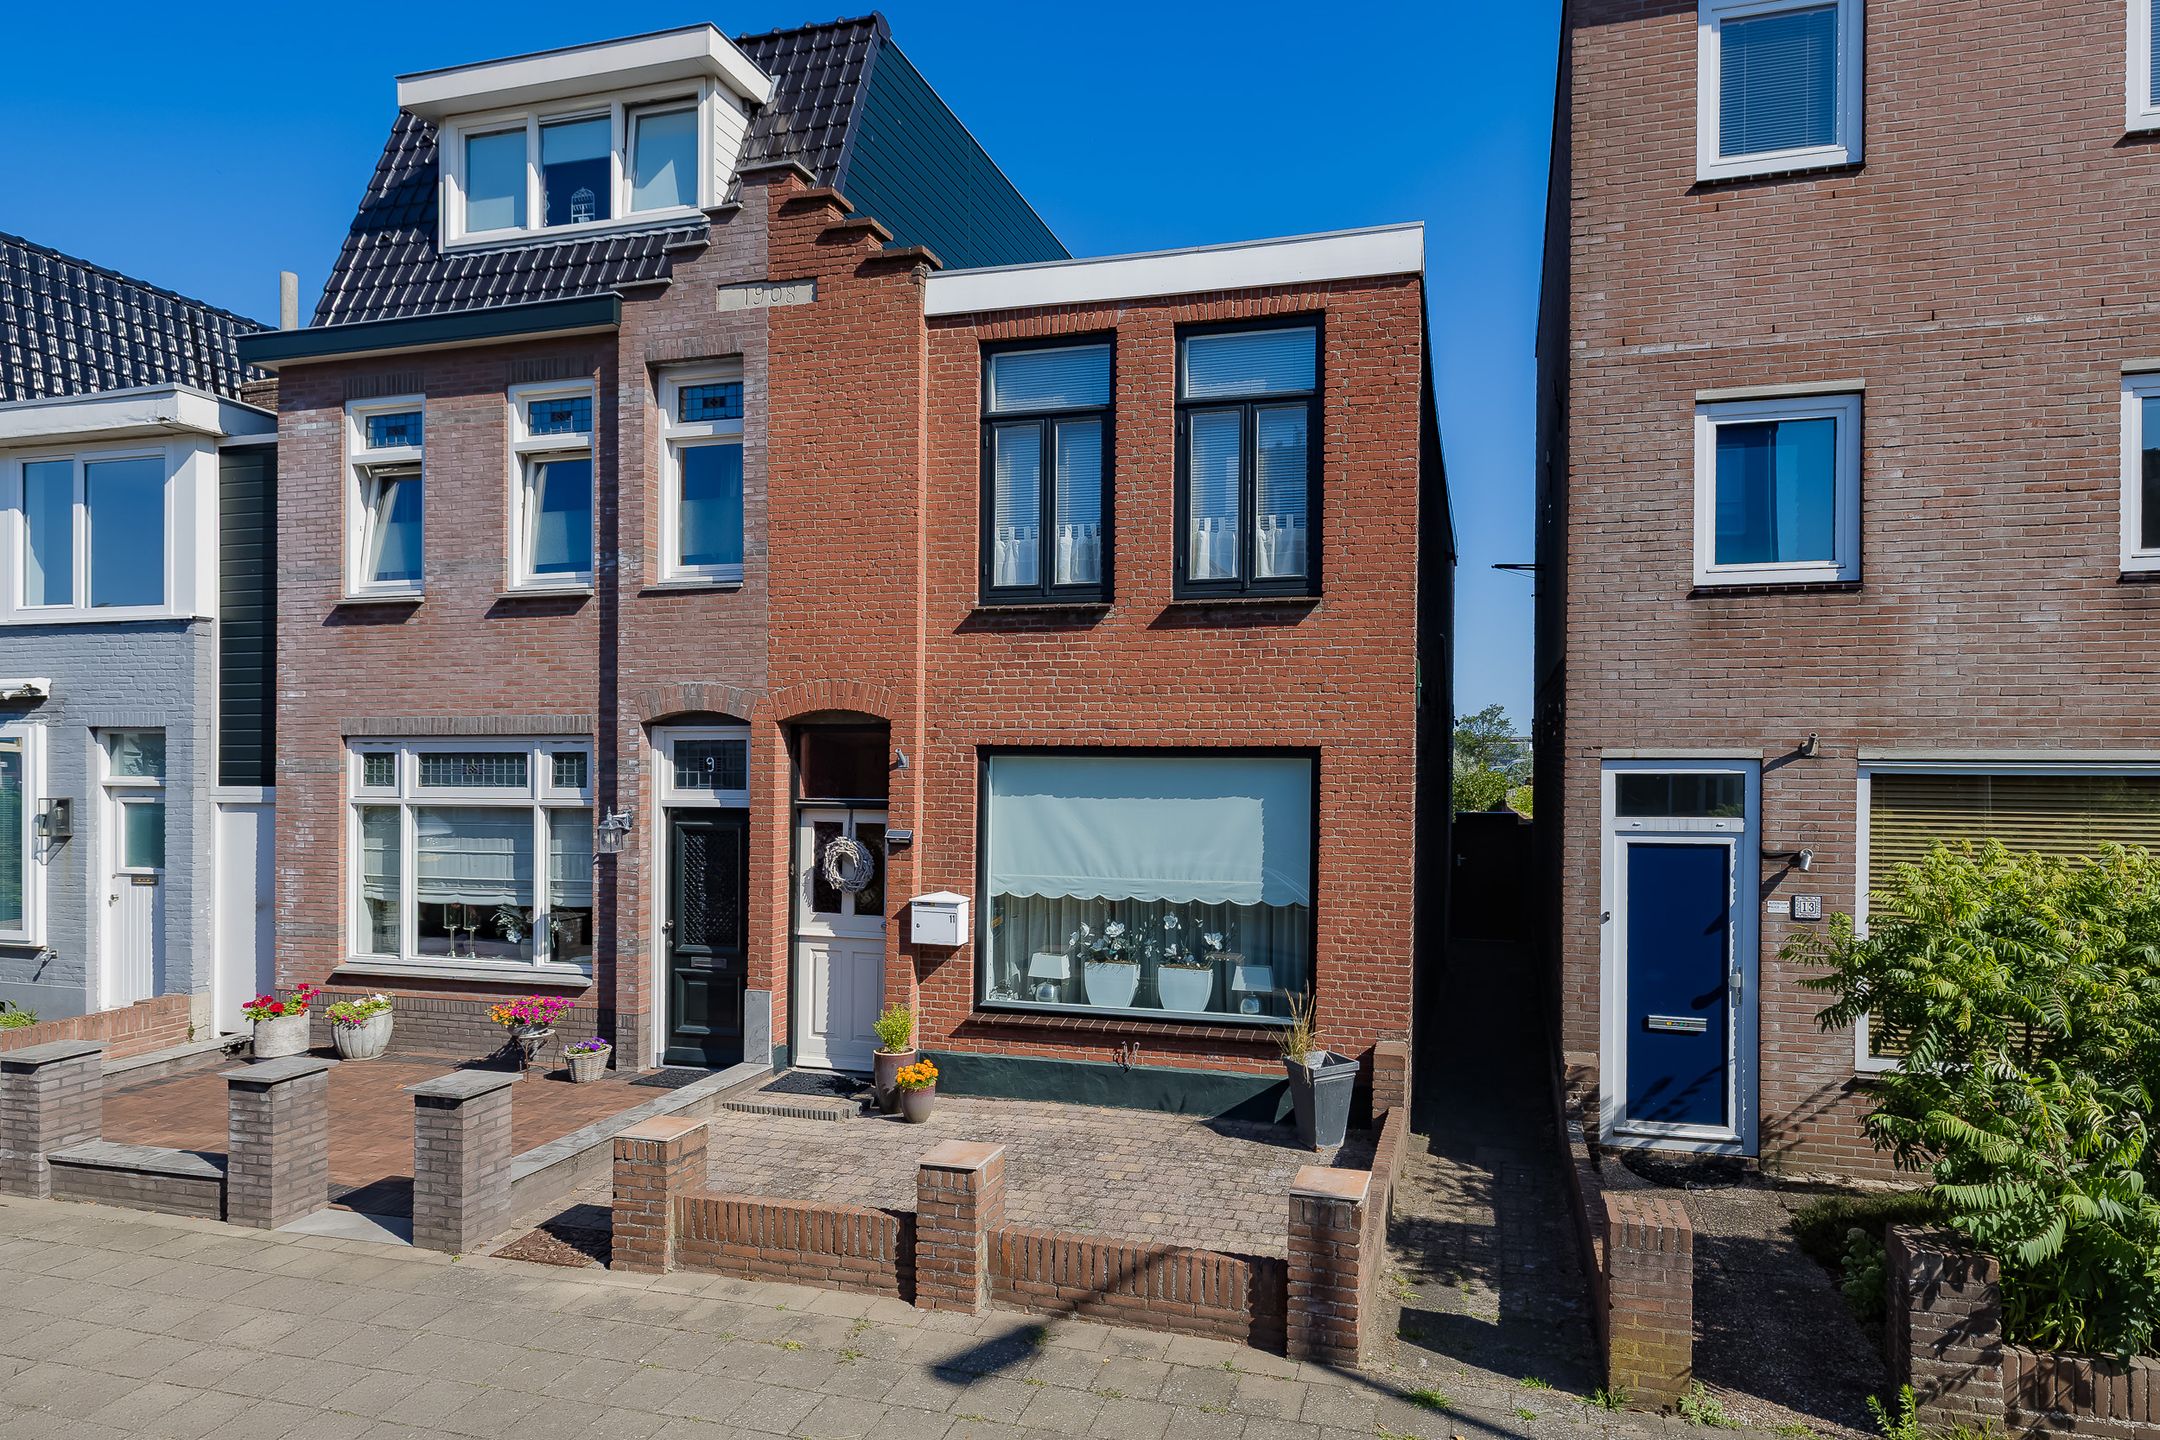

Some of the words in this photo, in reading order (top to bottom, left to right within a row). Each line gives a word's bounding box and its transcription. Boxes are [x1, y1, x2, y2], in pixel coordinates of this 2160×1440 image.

[744, 286, 796, 305] 1908
[706, 756, 715, 773] 9
[1802, 902, 1815, 912] 13
[949, 915, 955, 924] 11
